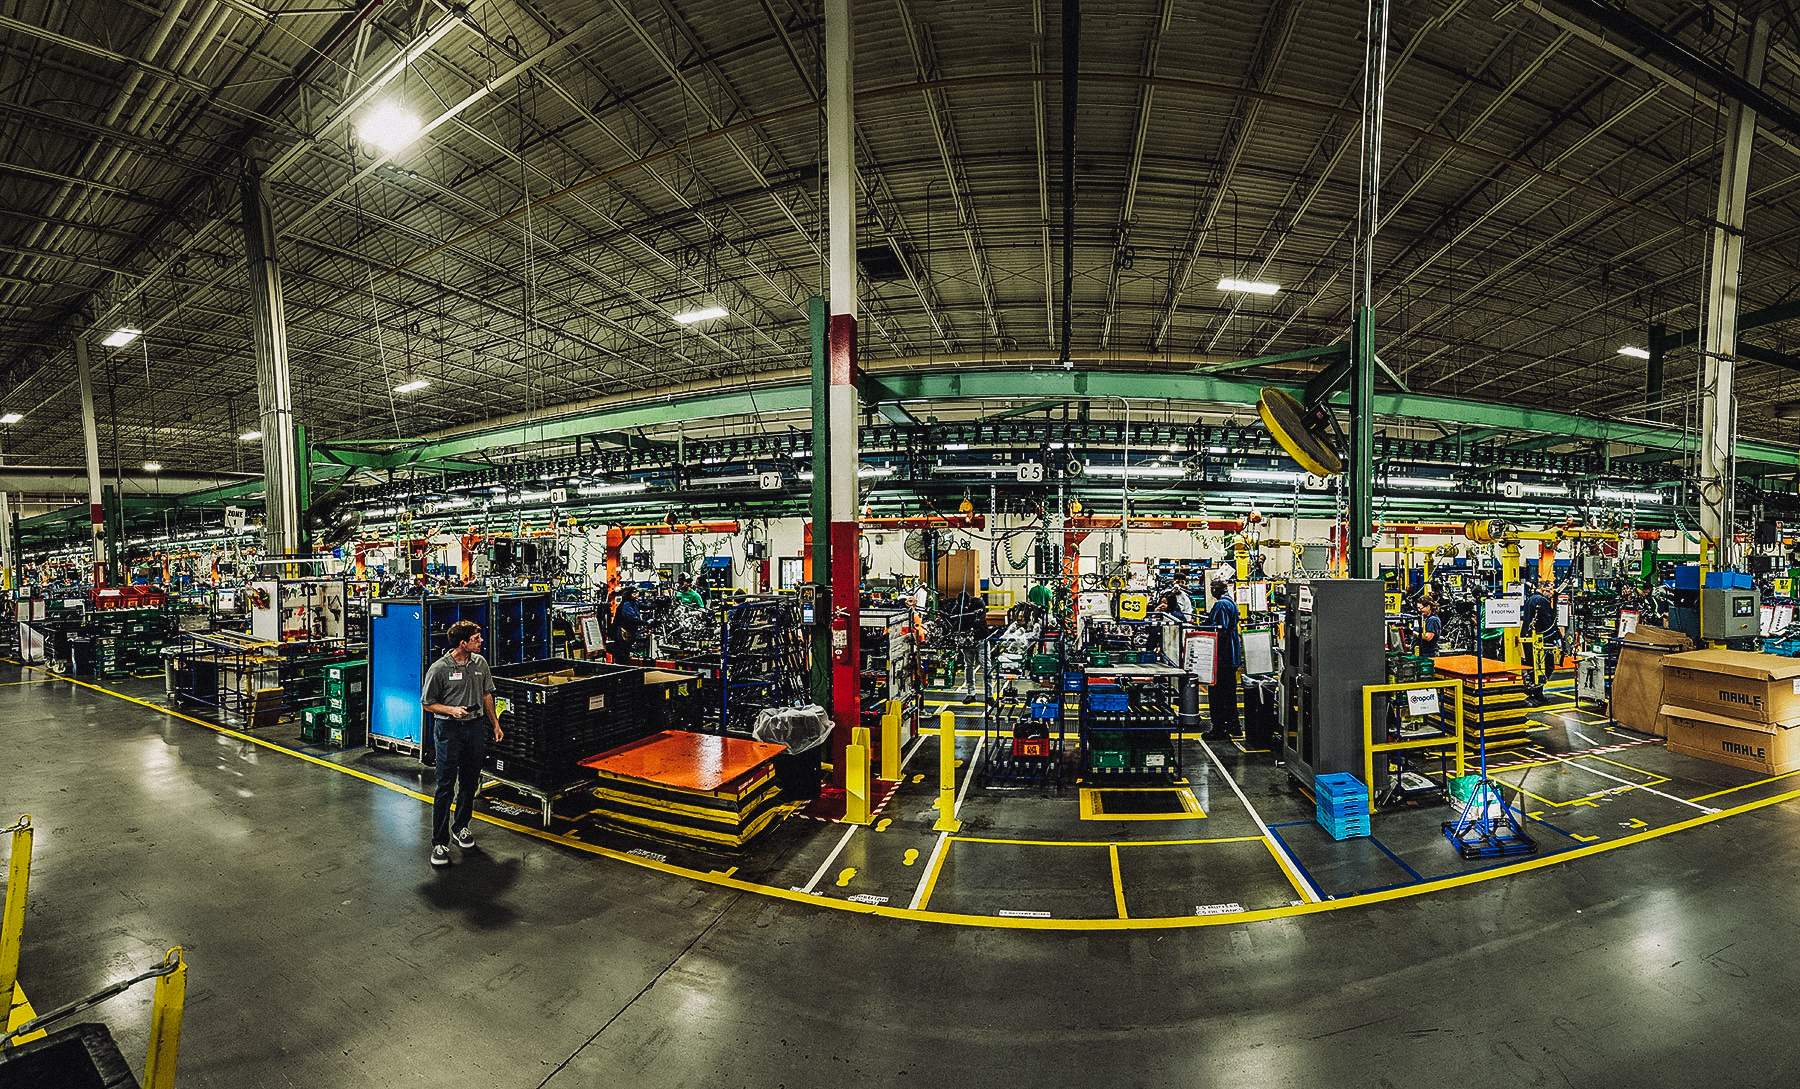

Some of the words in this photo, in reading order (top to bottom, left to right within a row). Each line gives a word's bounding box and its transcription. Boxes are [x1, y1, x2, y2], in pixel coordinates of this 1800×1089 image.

[228, 510, 243, 518] ZONE
[1719, 690, 1762, 706] MAHLE
[1721, 741, 1765, 758] MAHLE
